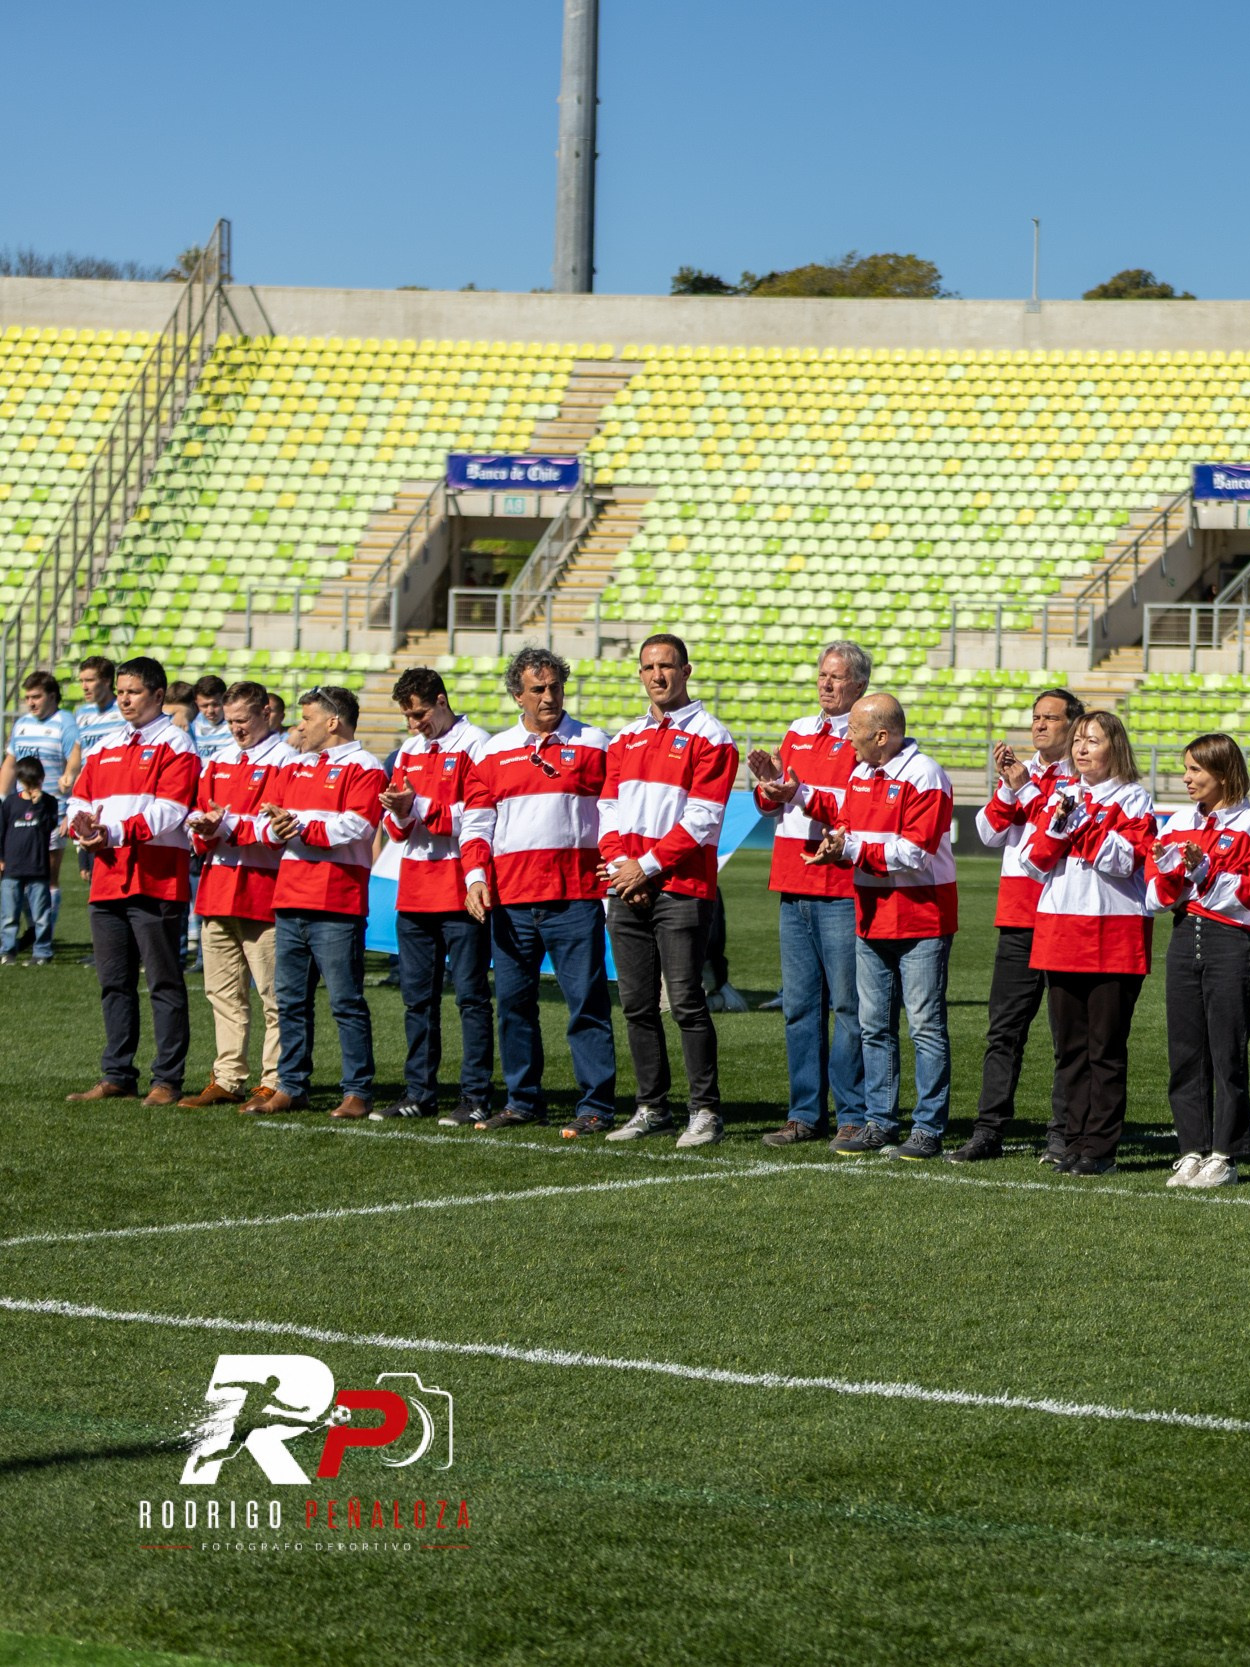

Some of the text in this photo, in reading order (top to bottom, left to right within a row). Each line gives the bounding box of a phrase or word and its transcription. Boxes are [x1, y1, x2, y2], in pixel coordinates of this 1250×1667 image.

[466, 463, 562, 483] Banco de Chile
